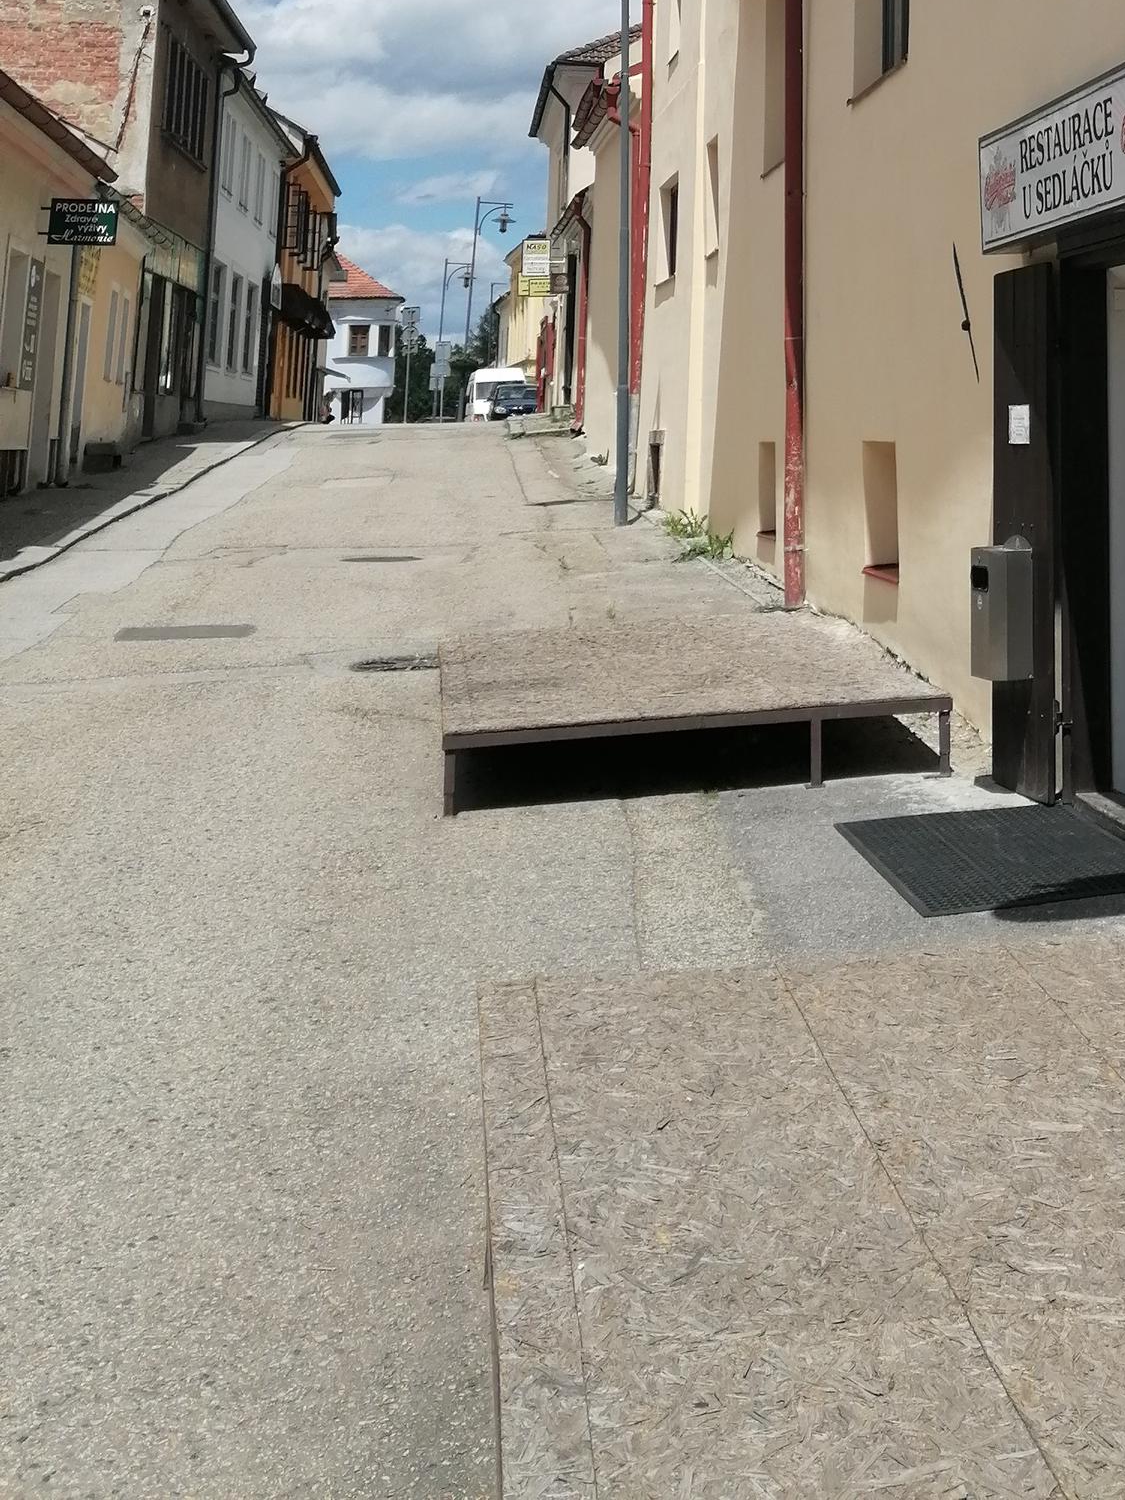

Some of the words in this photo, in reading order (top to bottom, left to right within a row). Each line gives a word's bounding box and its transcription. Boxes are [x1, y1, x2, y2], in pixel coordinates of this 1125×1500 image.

[1019, 97, 1115, 174] RESTAURACE
[1022, 183, 1032, 220] U
[1035, 139, 1114, 216] SEDLÁČKŮ
[55, 202, 116, 214] PRODEJNA
[50, 228, 114, 243] Harmonie
